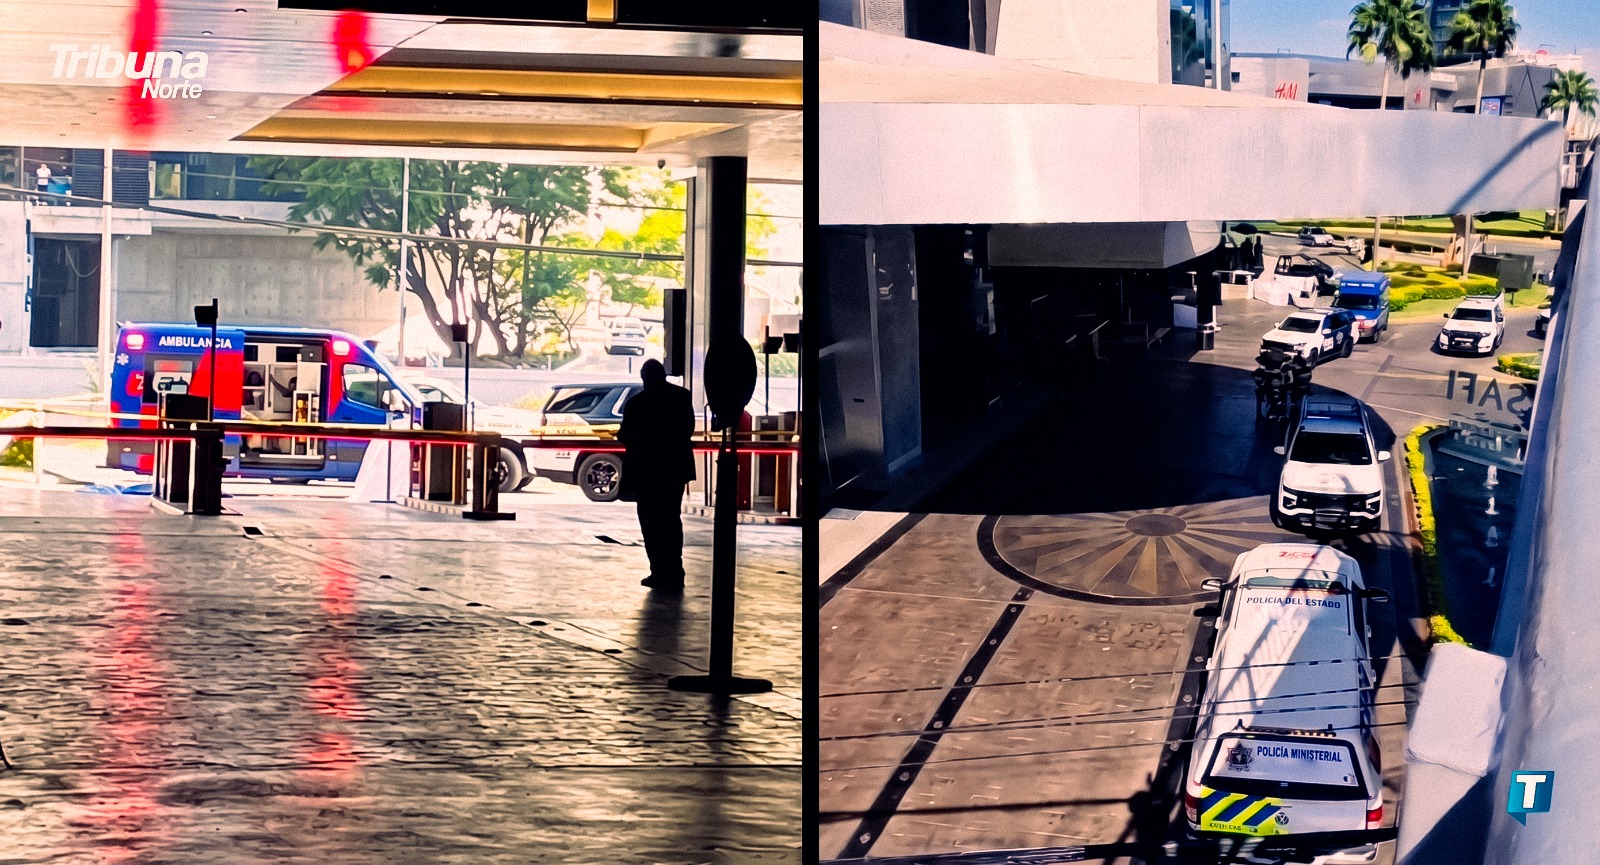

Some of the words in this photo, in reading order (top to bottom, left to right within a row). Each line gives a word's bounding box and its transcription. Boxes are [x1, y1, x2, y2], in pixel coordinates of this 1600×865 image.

[158, 335, 233, 349] AMBULANCIA
[1285, 597, 1303, 605] DEL
[1305, 598, 1341, 609] ESTADO
[1257, 745, 1289, 759] POLICÍA
[1291, 748, 1342, 763] MINISTERIAL
